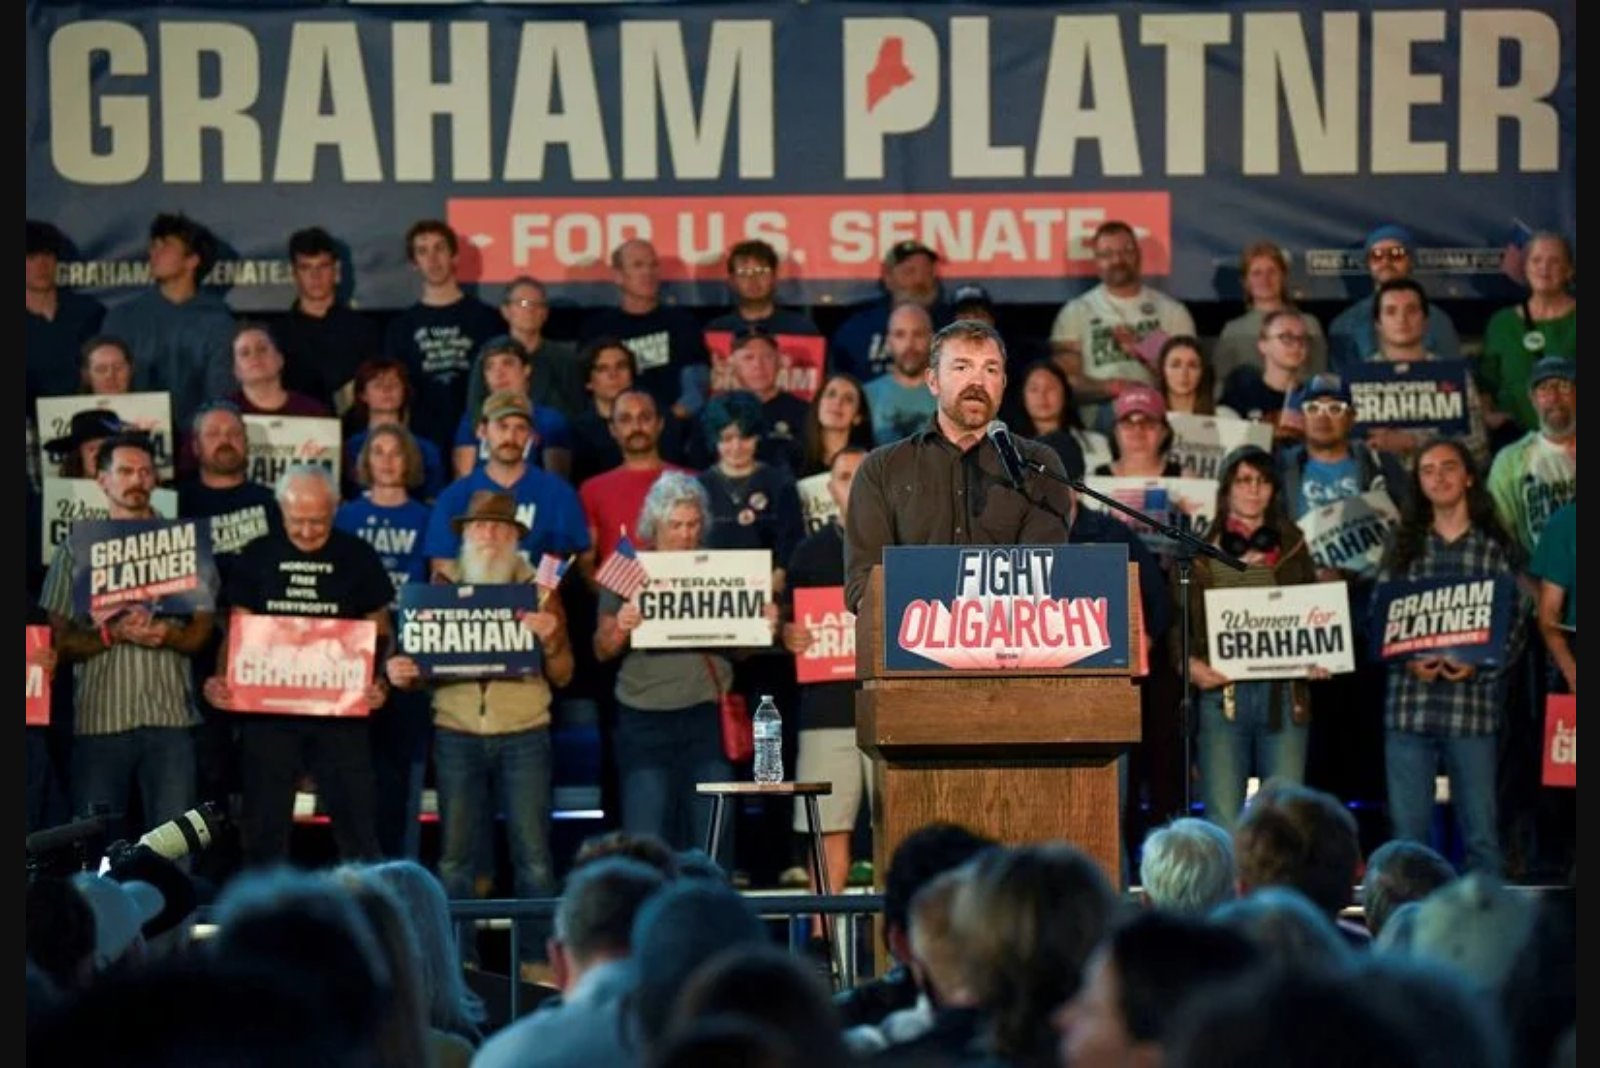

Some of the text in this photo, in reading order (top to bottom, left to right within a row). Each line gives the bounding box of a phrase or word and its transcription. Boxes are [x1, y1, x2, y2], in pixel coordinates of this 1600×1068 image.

[48, 9, 1561, 184] GRAHAM PLATNER
[829, 207, 1107, 264] SENATE
[90, 522, 196, 568] GRAHAM
[91, 549, 197, 596] PLATNER
[956, 548, 1055, 597] FIGHT
[403, 608, 513, 621] VTERANS
[639, 590, 765, 621] GRAHAM
[1221, 606, 1336, 630] Women for
[1388, 580, 1494, 621] GRAHAM
[403, 621, 535, 654] GRAHAM
[898, 597, 1112, 649] OLIGARCHY
[1217, 624, 1344, 660] GRAHAM
[1384, 605, 1492, 646] PLATNER
